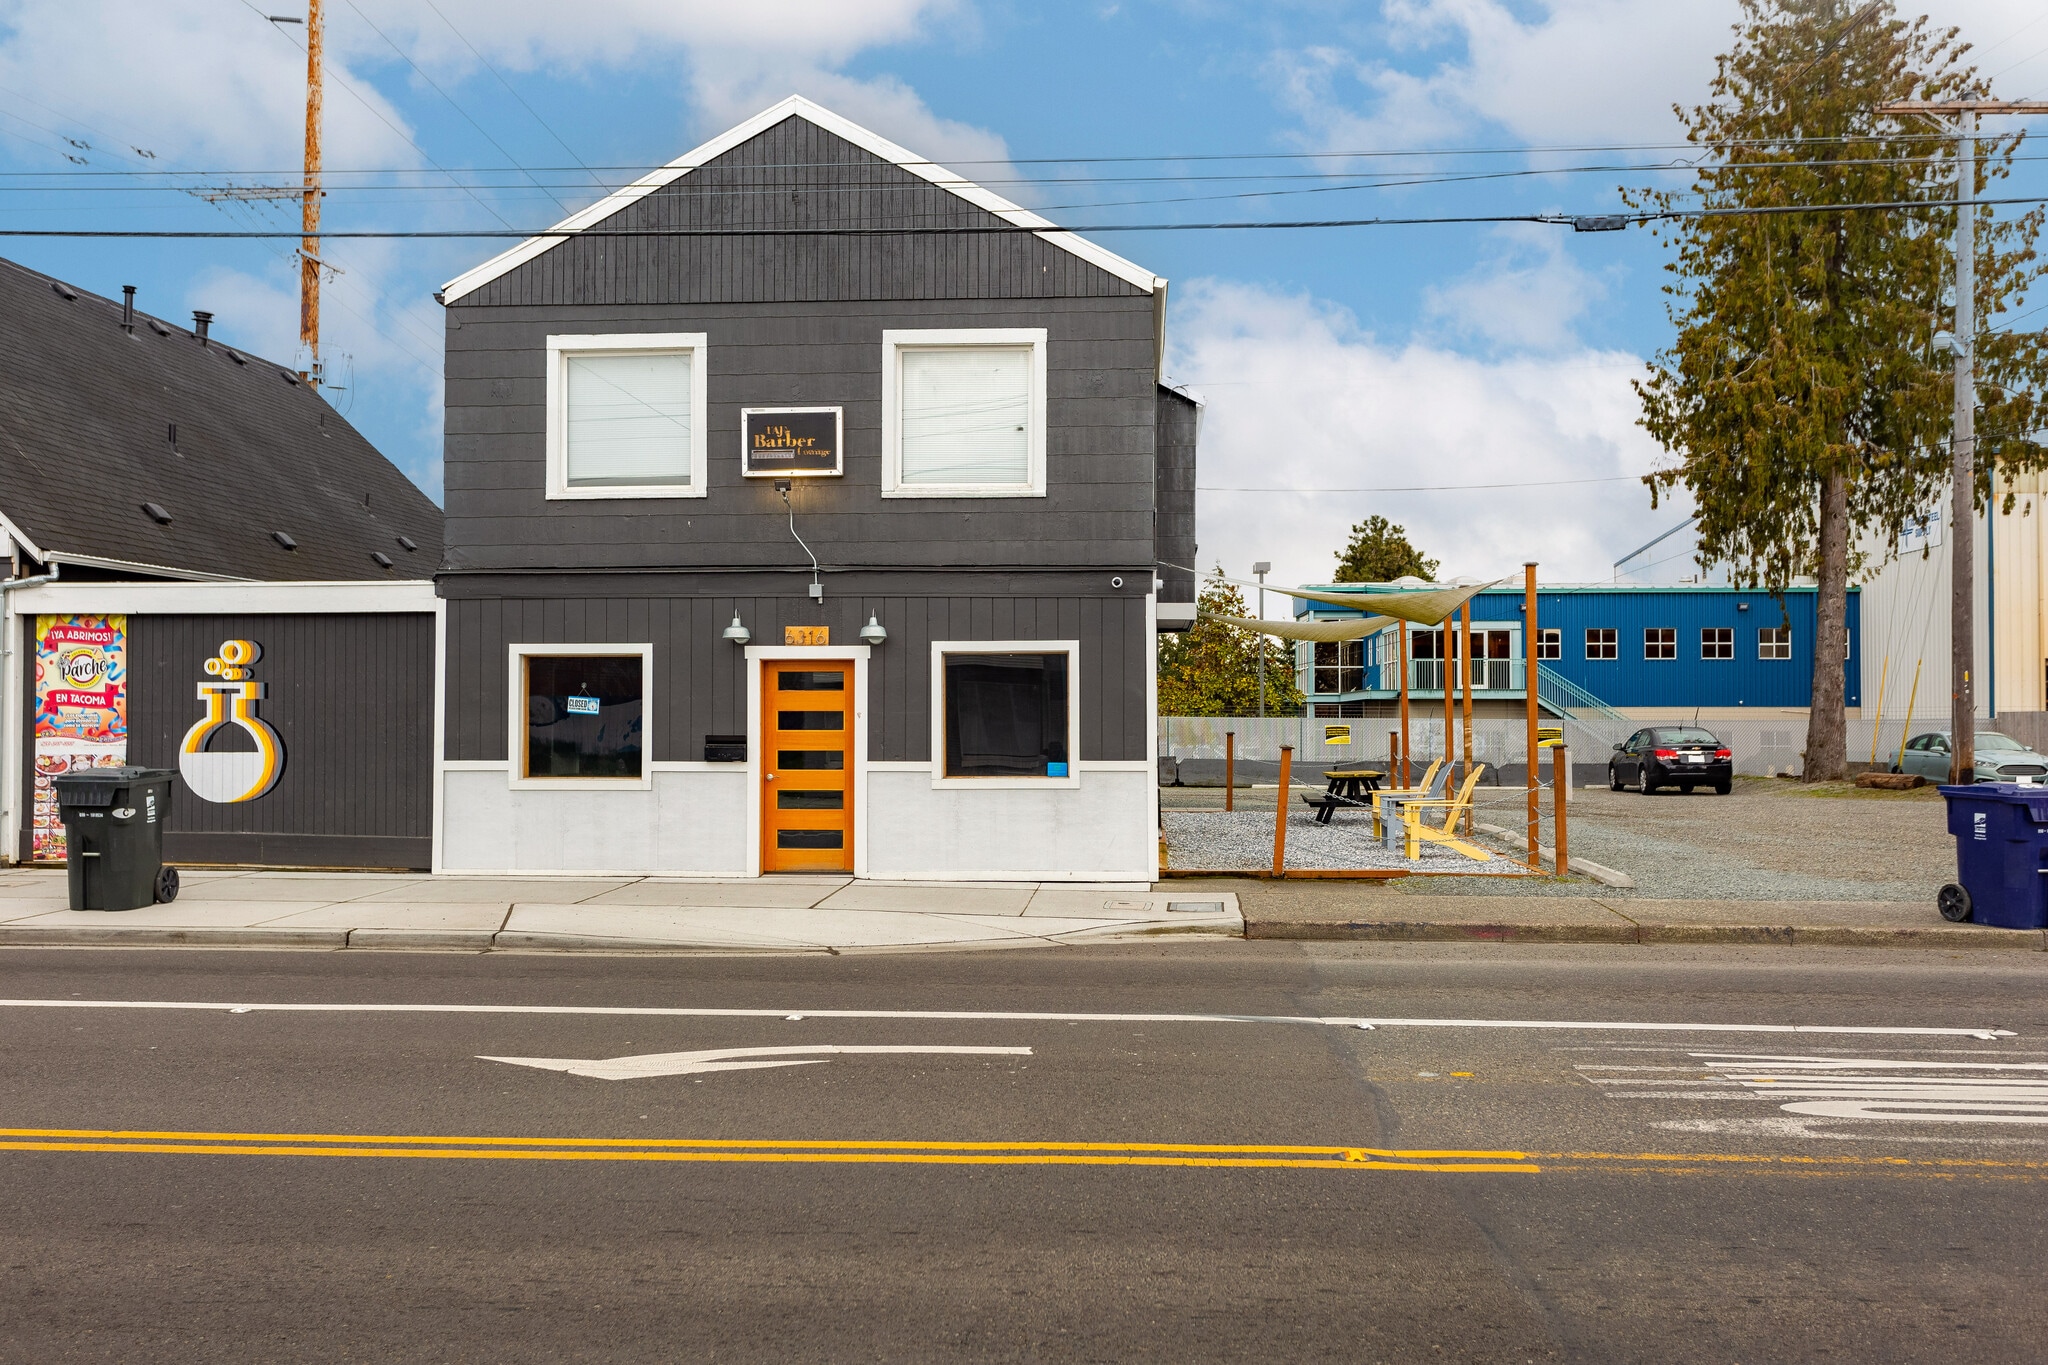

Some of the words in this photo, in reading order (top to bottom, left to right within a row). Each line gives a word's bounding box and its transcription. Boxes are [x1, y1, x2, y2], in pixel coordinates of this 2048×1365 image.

[754, 430, 816, 448] Barber
[51, 630, 65, 640] ¡YA
[67, 630, 112, 642] ABRIMOS!
[785, 629, 827, 645] 6316
[55, 693, 68, 703] EN
[70, 693, 106, 706] TACOMA
[569, 699, 587, 708] CLOSED
